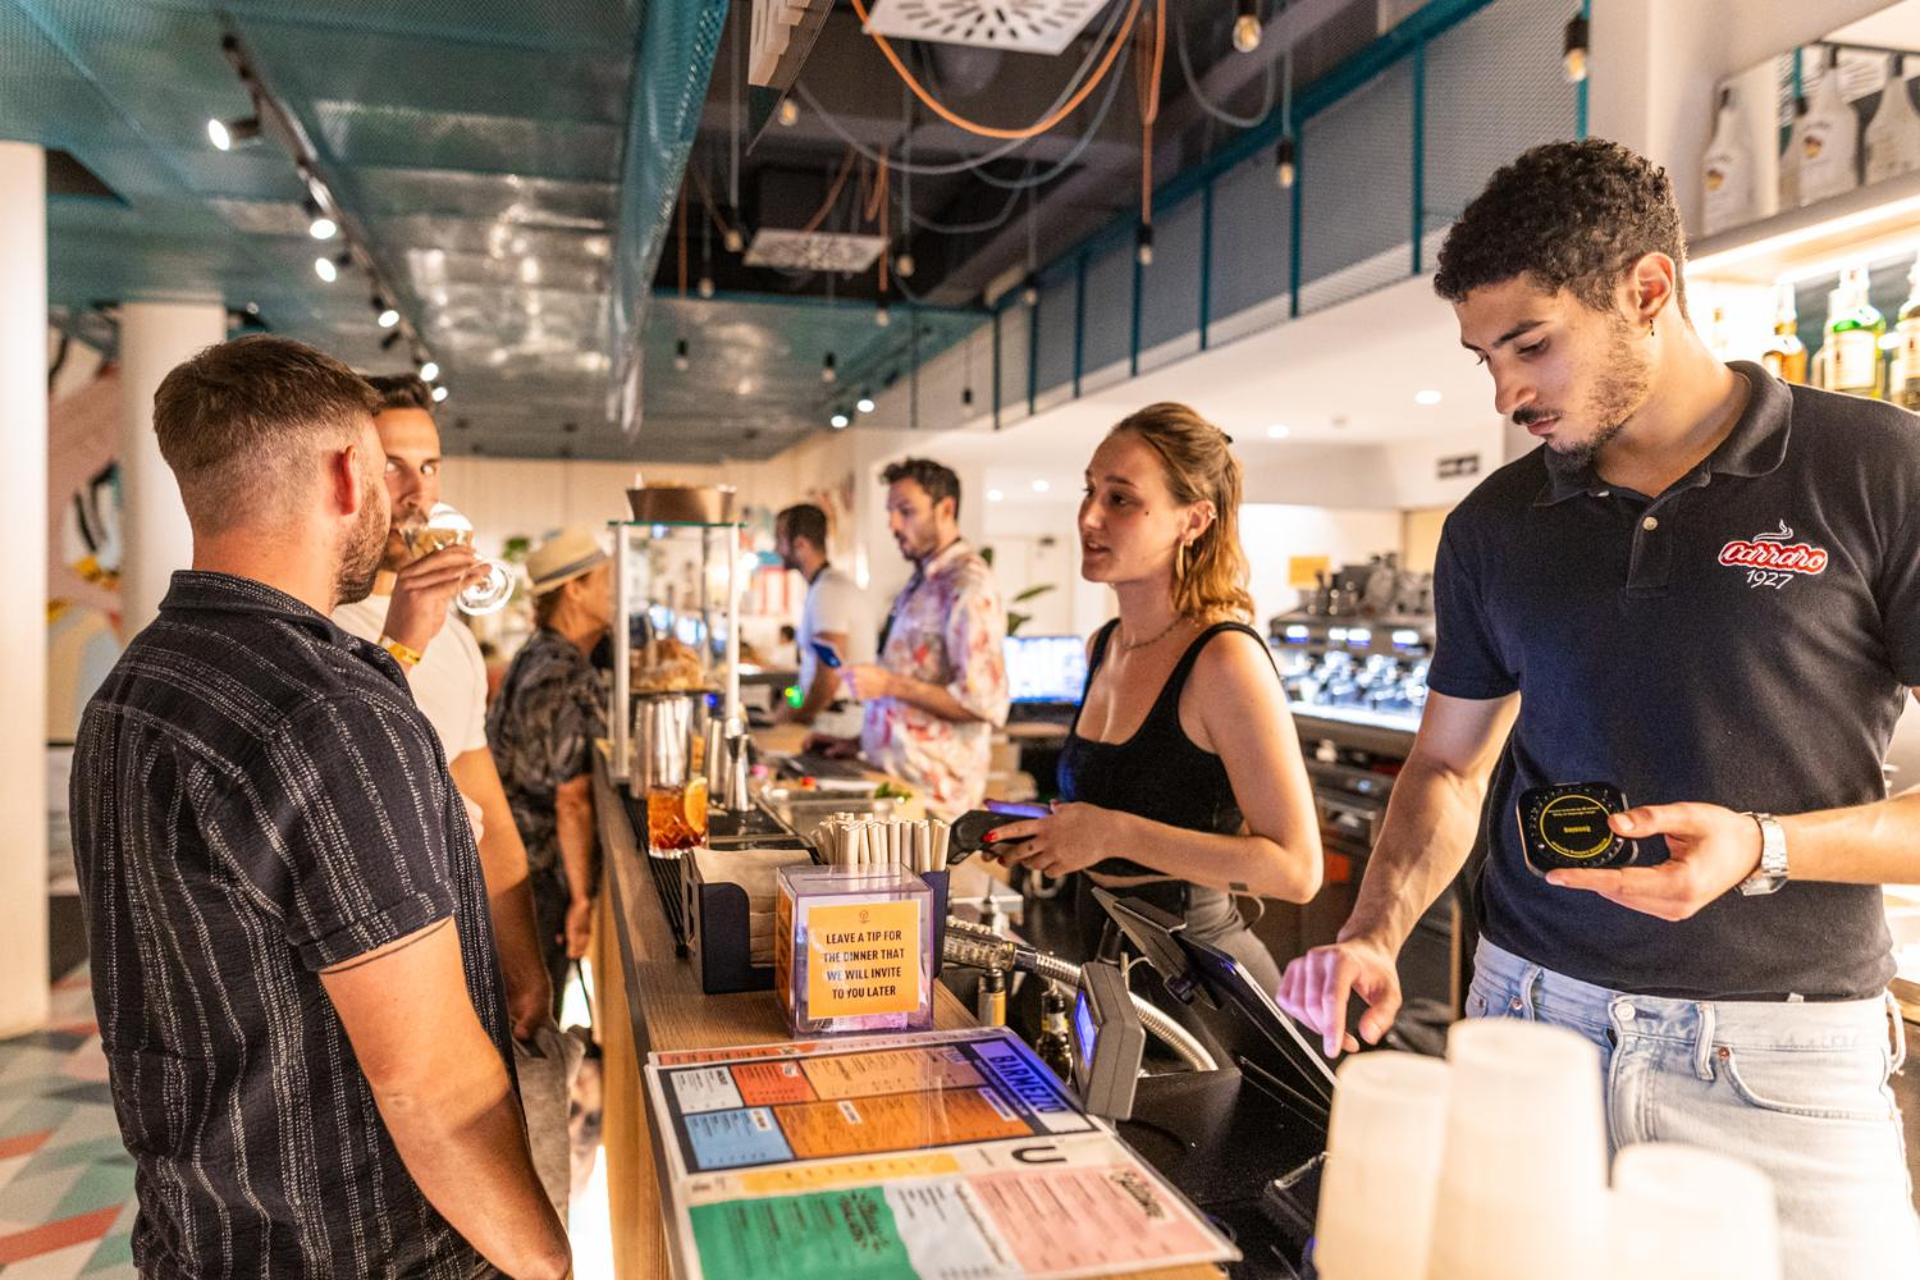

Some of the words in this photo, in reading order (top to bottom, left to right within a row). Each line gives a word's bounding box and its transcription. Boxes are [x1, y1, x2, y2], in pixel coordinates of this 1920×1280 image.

[1746, 568, 1794, 590] 1927
[826, 932, 855, 944] LEAVE
[858, 932, 864, 942] A
[866, 931, 881, 942] TIP
[884, 930, 901, 940] FOR
[824, 951, 841, 963] THE
[843, 950, 879, 962] DINNER
[881, 948, 904, 959] THAT
[827, 970, 843, 982] WE
[845, 968, 869, 980] WILL
[871, 967, 901, 978] INVITE
[832, 989, 844, 999] TO
[847, 987, 865, 999] YOU
[867, 986, 896, 997] LATER
